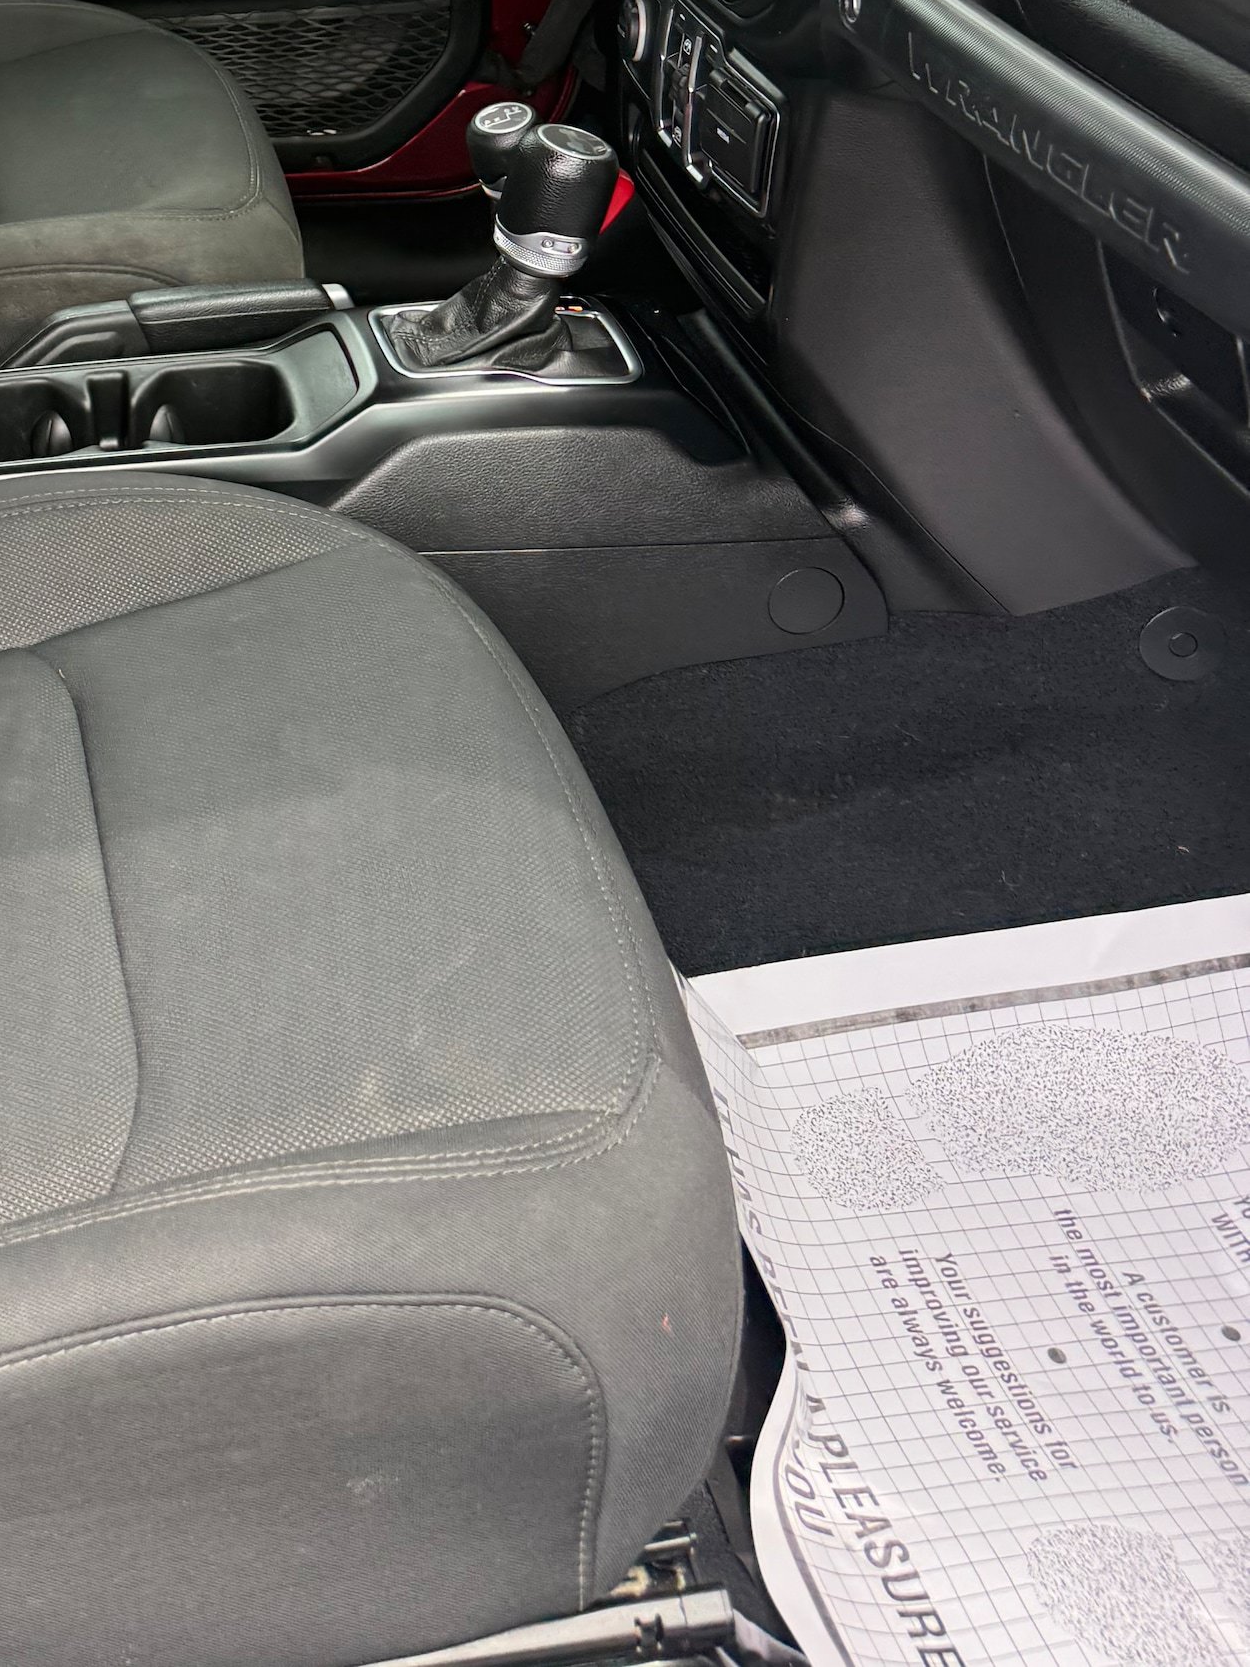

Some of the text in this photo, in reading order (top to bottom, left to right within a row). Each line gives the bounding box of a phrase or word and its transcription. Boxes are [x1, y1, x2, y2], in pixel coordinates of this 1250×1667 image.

[908, 31, 1190, 276] WRANGLER
[869, 1254, 1007, 1483] are always welcome.
[898, 1248, 1048, 1483] improving our service
[934, 1252, 1080, 1470] Your suggestions for
[1049, 1254, 1180, 1444] in the world to us.
[1053, 1208, 1250, 1486] the most important person
[1122, 1270, 1231, 1414] A customer is
[807, 1431, 967, 1667] PLEASURE
